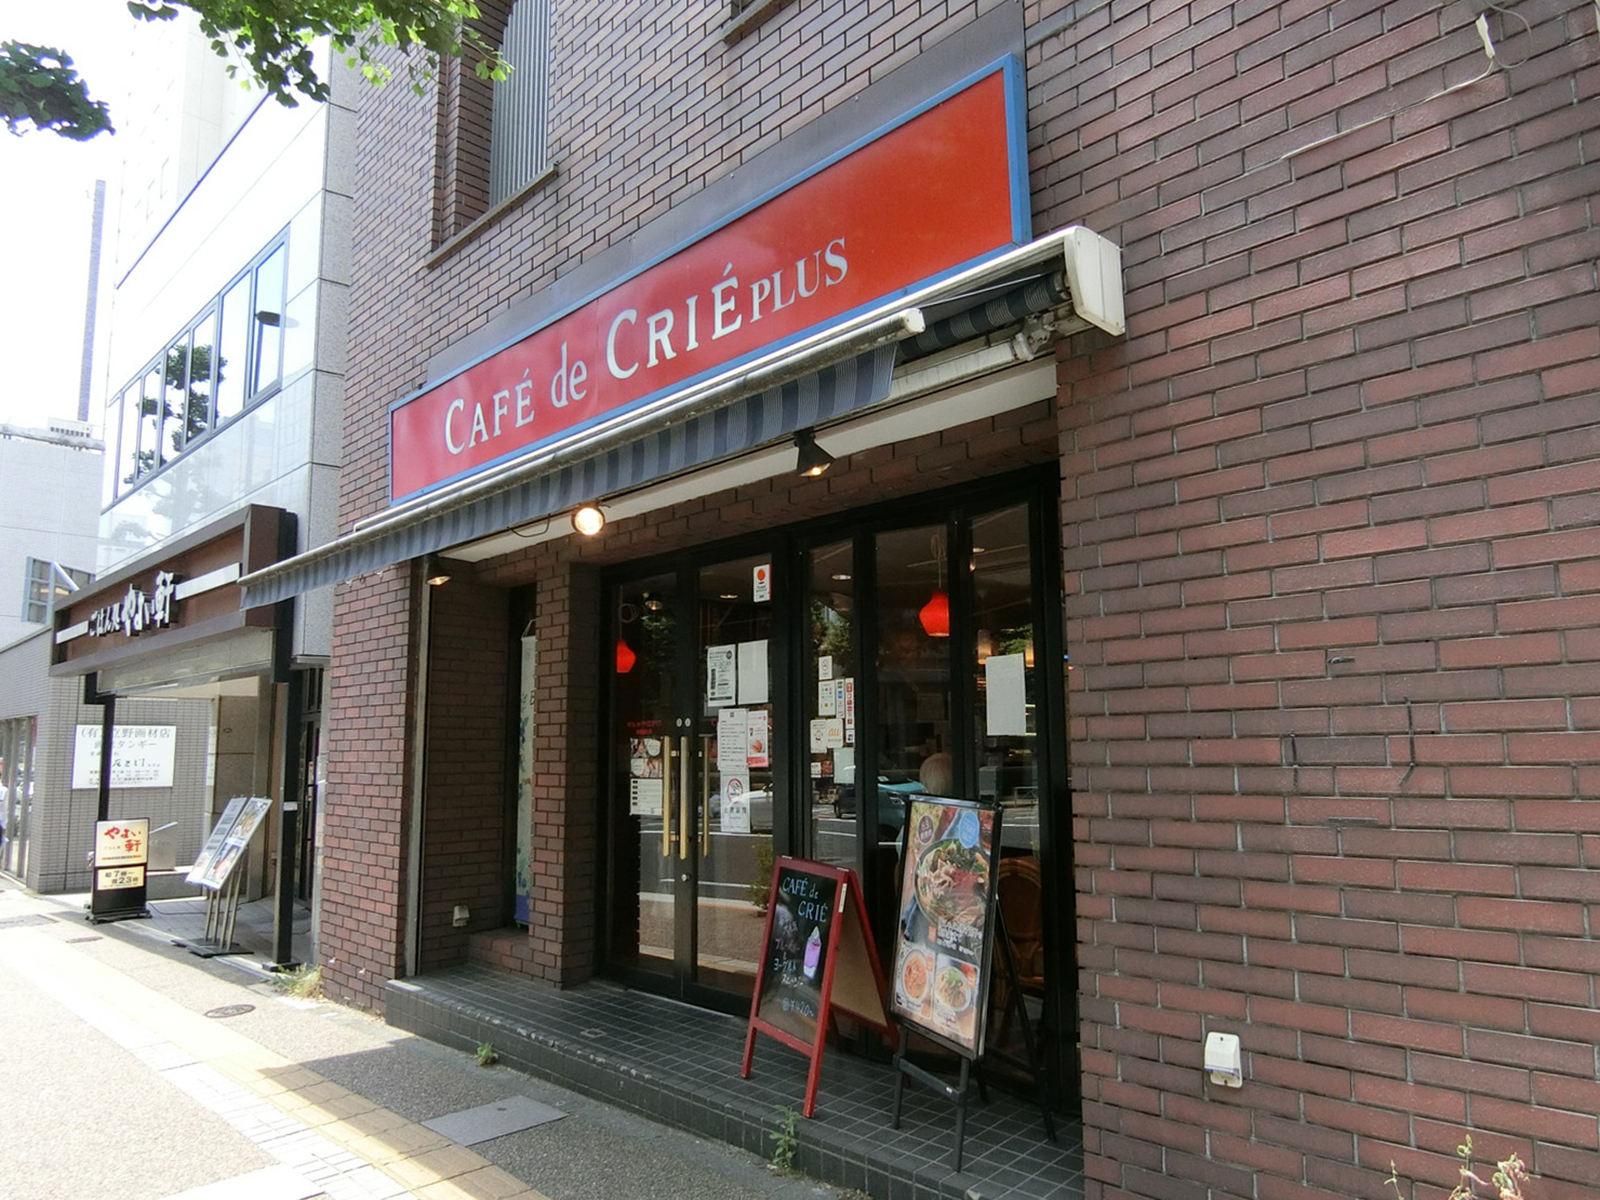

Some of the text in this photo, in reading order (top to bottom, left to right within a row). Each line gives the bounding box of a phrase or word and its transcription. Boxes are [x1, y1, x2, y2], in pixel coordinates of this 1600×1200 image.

[444, 237, 850, 456] CAFÉ de CRIÉ PLUS
[89, 570, 175, 637] ごはん処 やよい軒
[104, 826, 142, 840] やよい
[124, 839, 142, 853] 軒
[782, 876, 819, 899] CAFÉ de
[797, 900, 829, 923] CRIÉ
